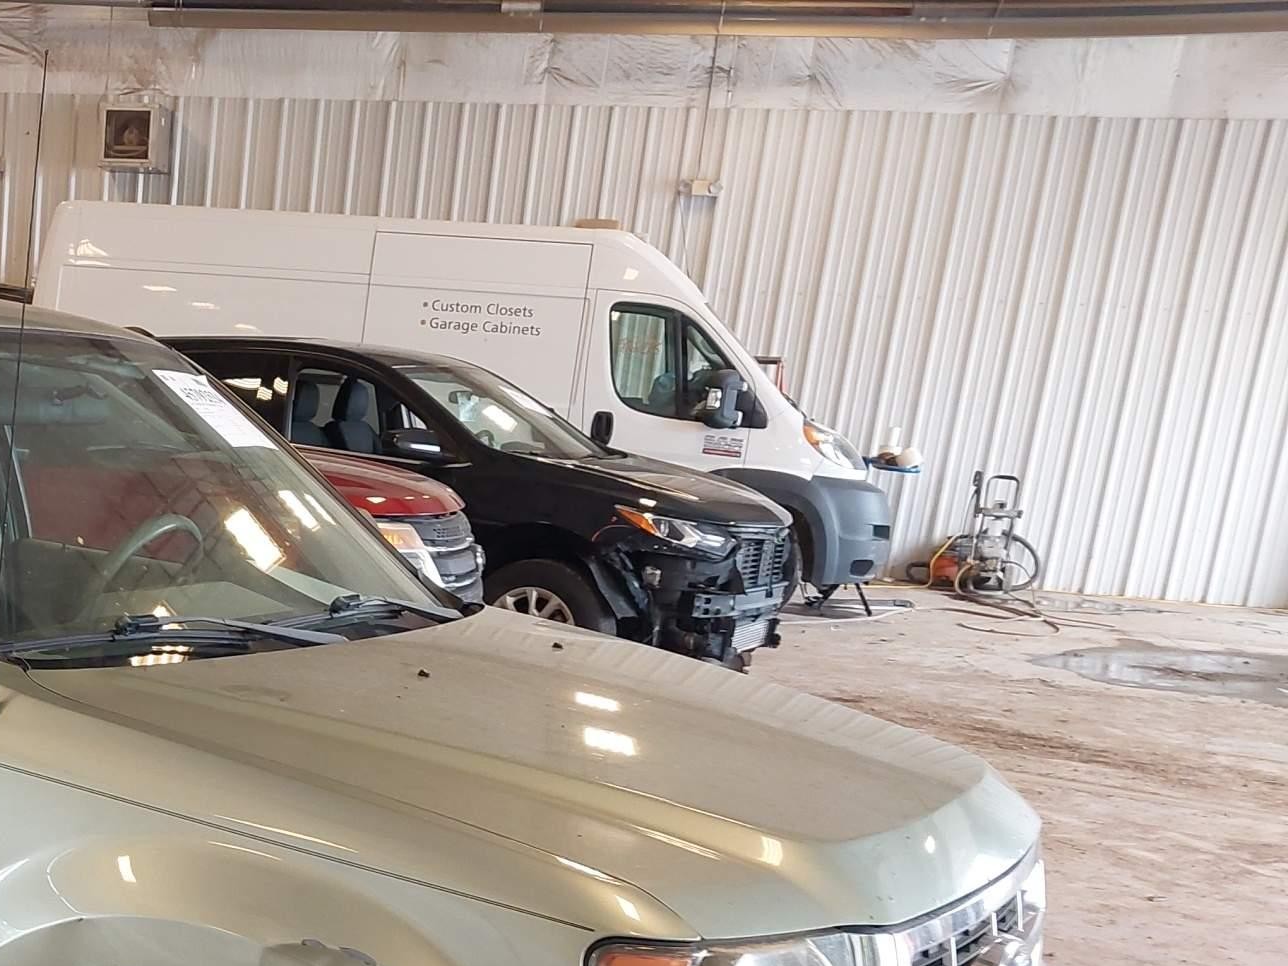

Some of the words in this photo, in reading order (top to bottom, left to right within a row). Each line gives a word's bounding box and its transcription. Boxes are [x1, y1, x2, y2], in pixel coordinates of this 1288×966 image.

[431, 299, 482, 314] Custom
[486, 303, 534, 318] Closets
[429, 317, 478, 334] Garage
[482, 320, 542, 336] Cabinets
